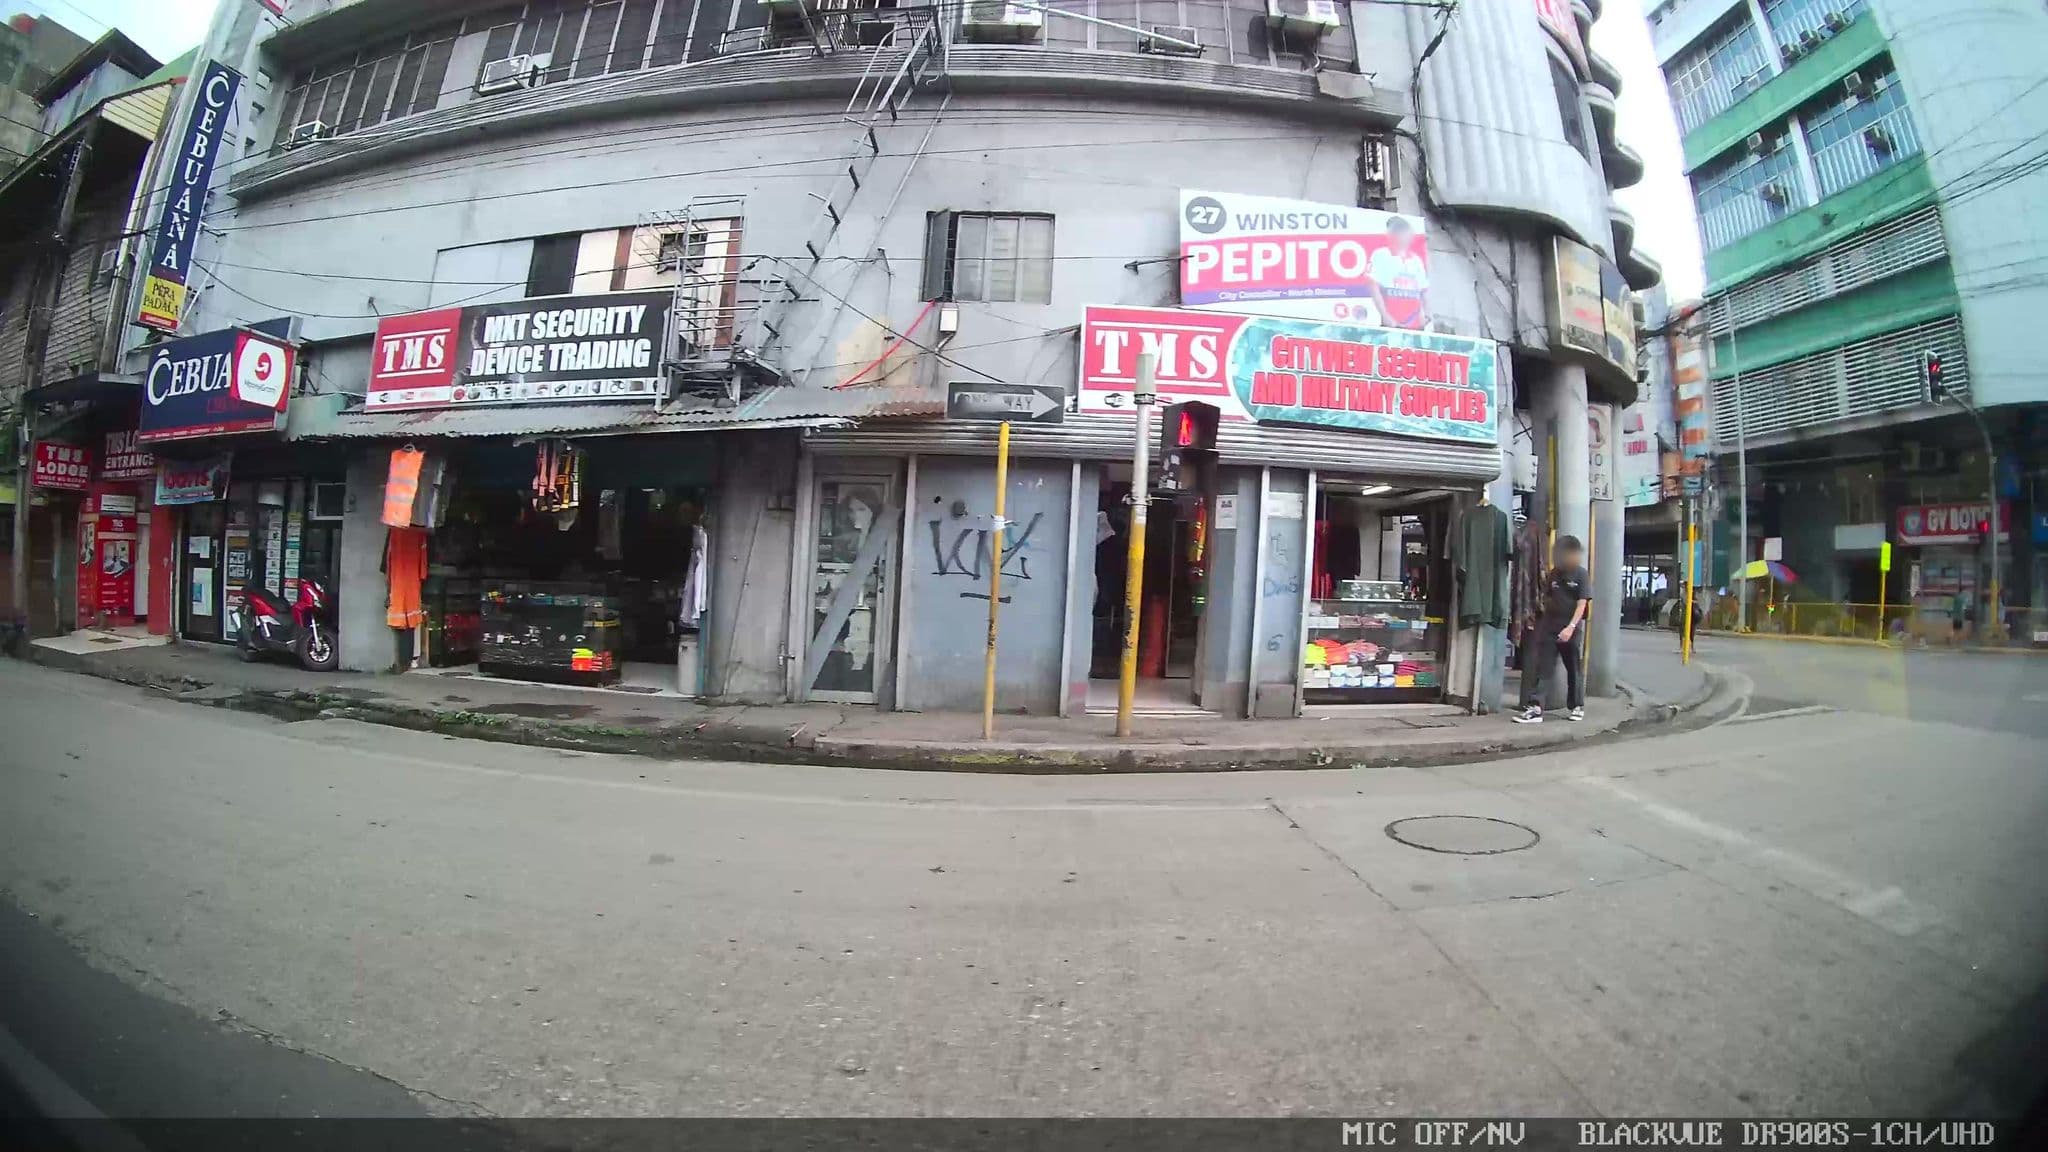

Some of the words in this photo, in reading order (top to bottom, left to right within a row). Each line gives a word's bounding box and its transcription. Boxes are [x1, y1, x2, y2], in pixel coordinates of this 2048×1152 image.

[160, 71, 230, 270] CEBUANA
[1191, 205, 1222, 225] 27
[1236, 212, 1348, 231] WINSTON
[1187, 240, 1367, 285] PEPITO
[143, 295, 179, 316] PADALA
[152, 283, 176, 302] PERA
[483, 313, 531, 343] MXT
[532, 305, 647, 339] SECURITY
[382, 334, 447, 373] TMS
[470, 345, 545, 376] DEVICE
[549, 338, 652, 371] TRADING
[1095, 329, 1219, 379] TMS
[1377, 345, 1470, 387] SECURITY
[1250, 371, 1298, 407] AND
[1301, 375, 1397, 415] MILITARY
[1399, 383, 1487, 424] SUPPLIES
[36, 460, 88, 478] LODGE
[105, 453, 155, 469] ENTRANCE
